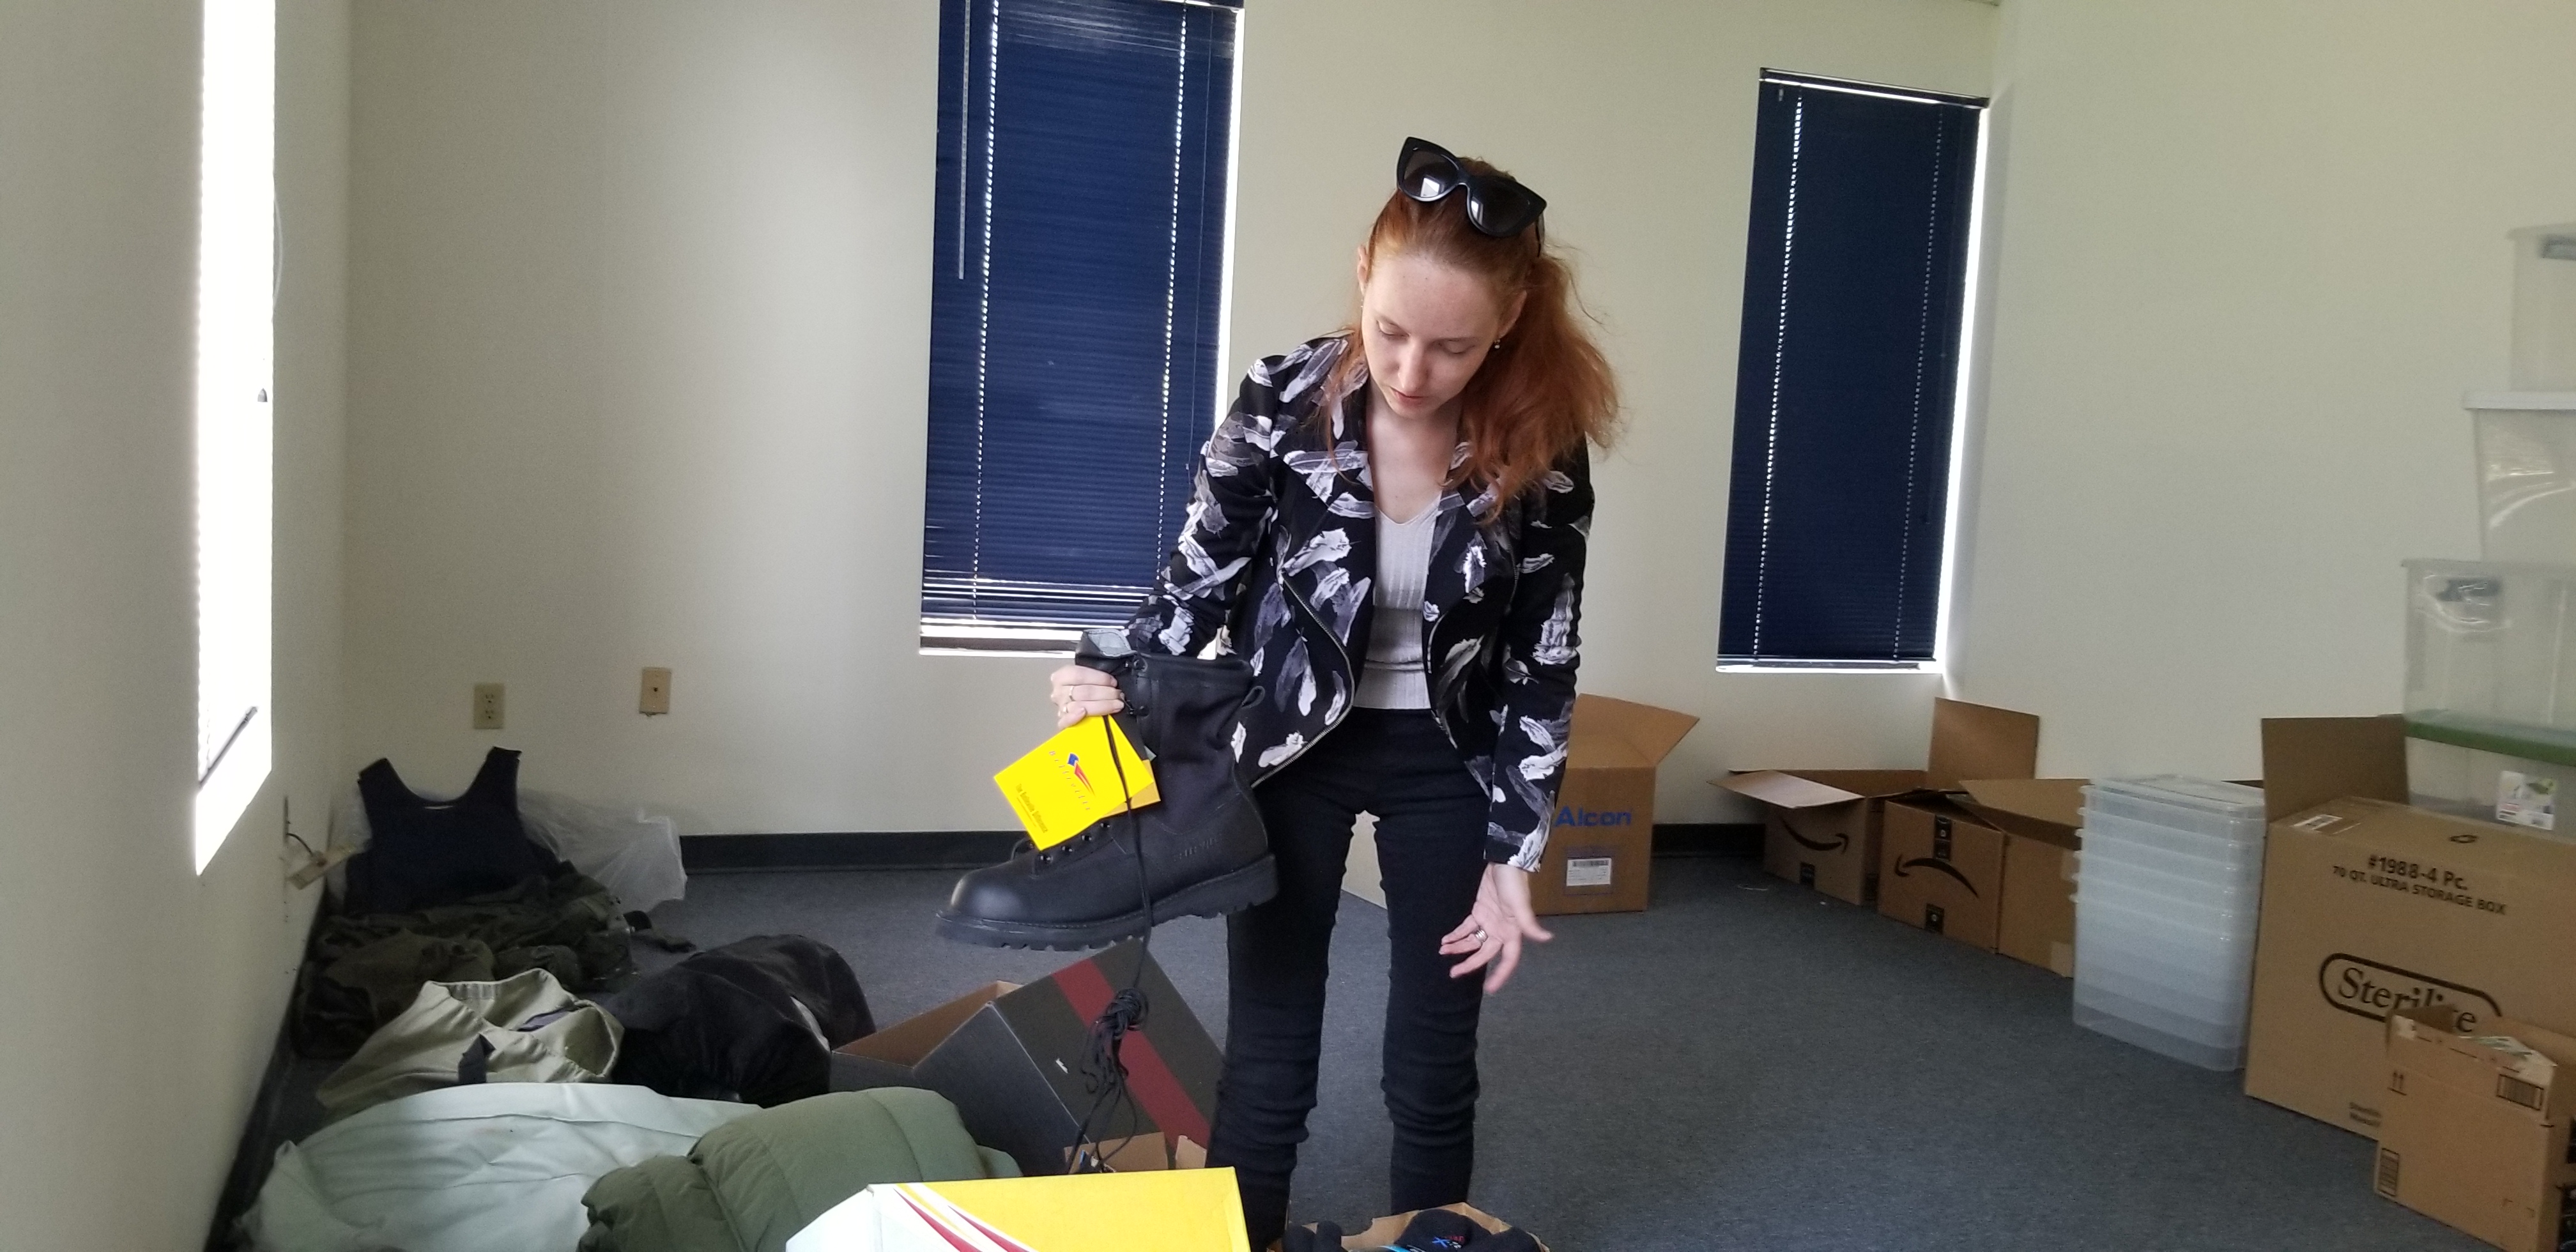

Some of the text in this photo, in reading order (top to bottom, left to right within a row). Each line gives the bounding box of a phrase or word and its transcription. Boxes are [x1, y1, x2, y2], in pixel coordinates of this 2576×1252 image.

[1554, 805, 1632, 827] Alcon
[2368, 855, 2437, 883] #1988-4
[2333, 865, 2347, 878] 70
[2371, 874, 2409, 892] ULTRA
[2412, 884, 2473, 908] STORAGE
[2478, 898, 2507, 915] BOX
[2338, 966, 2476, 1033] Sterile
